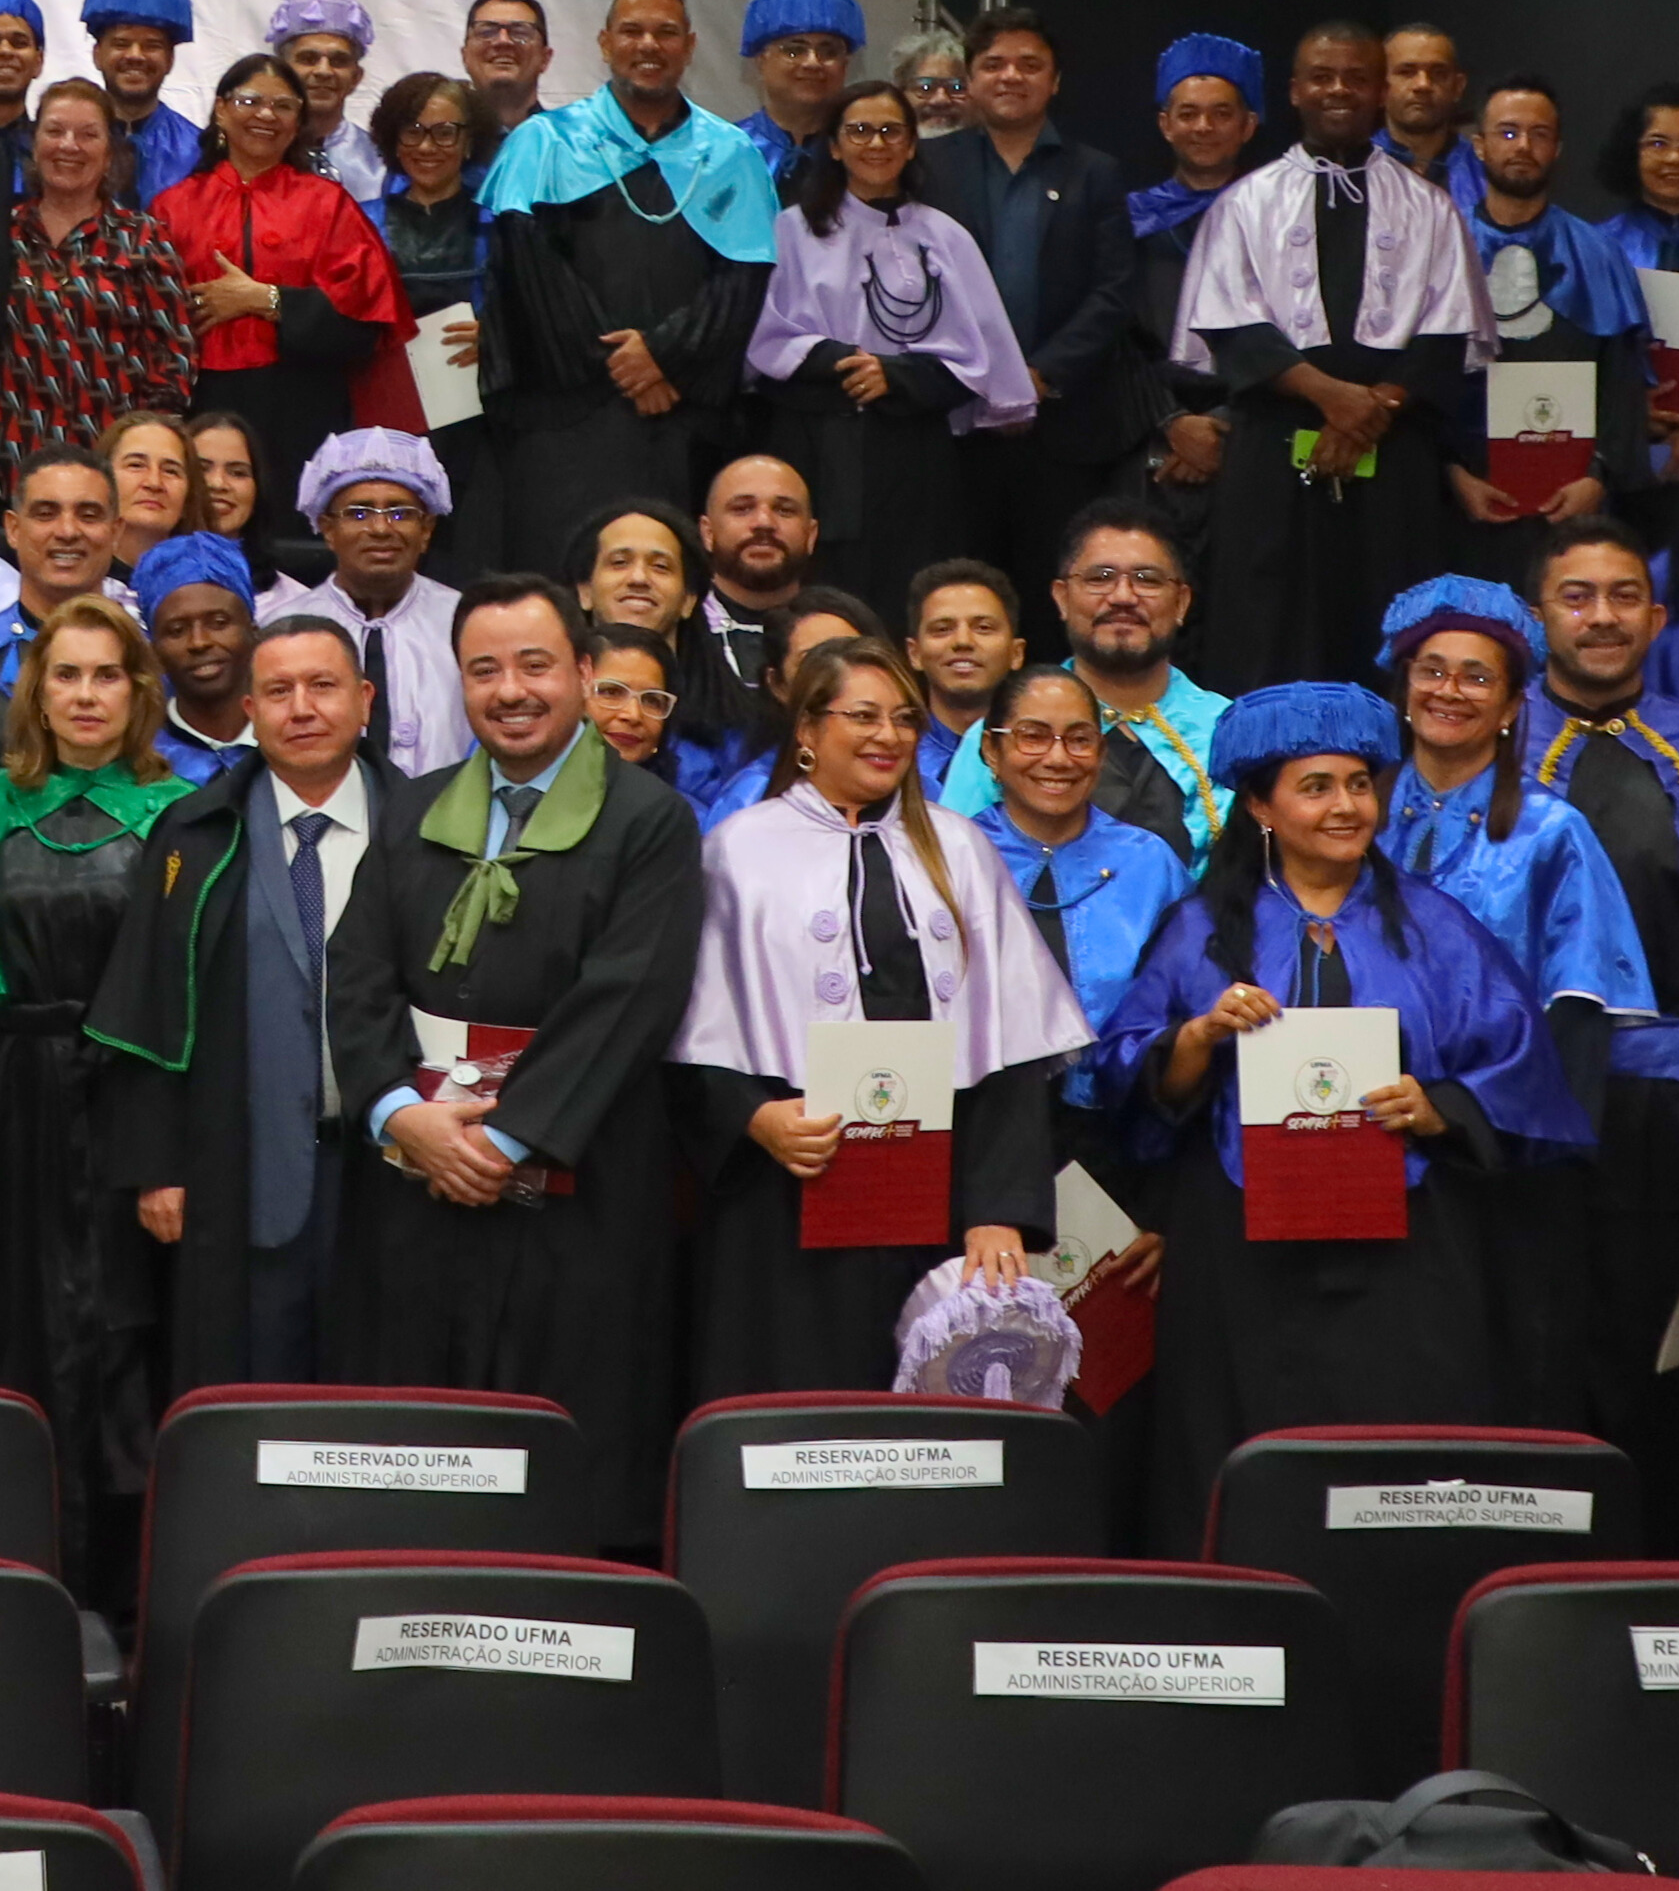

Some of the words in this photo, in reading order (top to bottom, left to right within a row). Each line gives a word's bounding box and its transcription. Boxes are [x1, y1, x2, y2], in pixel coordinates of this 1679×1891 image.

[313, 1451, 419, 1467] RESERVADO
[425, 1453, 472, 1468] UFMA
[795, 1449, 899, 1466] RESERVADO
[904, 1447, 952, 1462] UFMA
[286, 1470, 415, 1488] ADMINISTRAÇÃO
[419, 1472, 498, 1488] SUPERIOR
[771, 1466, 896, 1484] ADMINISTRAÇÃO
[900, 1466, 977, 1482] SUPERIOR
[1380, 1490, 1481, 1507] RESERVADO
[1487, 1490, 1537, 1506] UFMA
[1354, 1507, 1476, 1525] ADMINISTRAÇÃO
[1481, 1509, 1564, 1526] SUPERIOR
[400, 1621, 508, 1642] RESERVADO
[514, 1626, 572, 1647] UFMA
[375, 1644, 501, 1666] ADMINISTRAÇÃO
[507, 1649, 601, 1672] SUPERIOR
[1038, 1650, 1161, 1669] RESERVADO
[1167, 1651, 1224, 1670] UFMA
[1007, 1672, 1157, 1693] ADMINISTRAÇÃO
[1162, 1675, 1256, 1693] SUPERIOR
